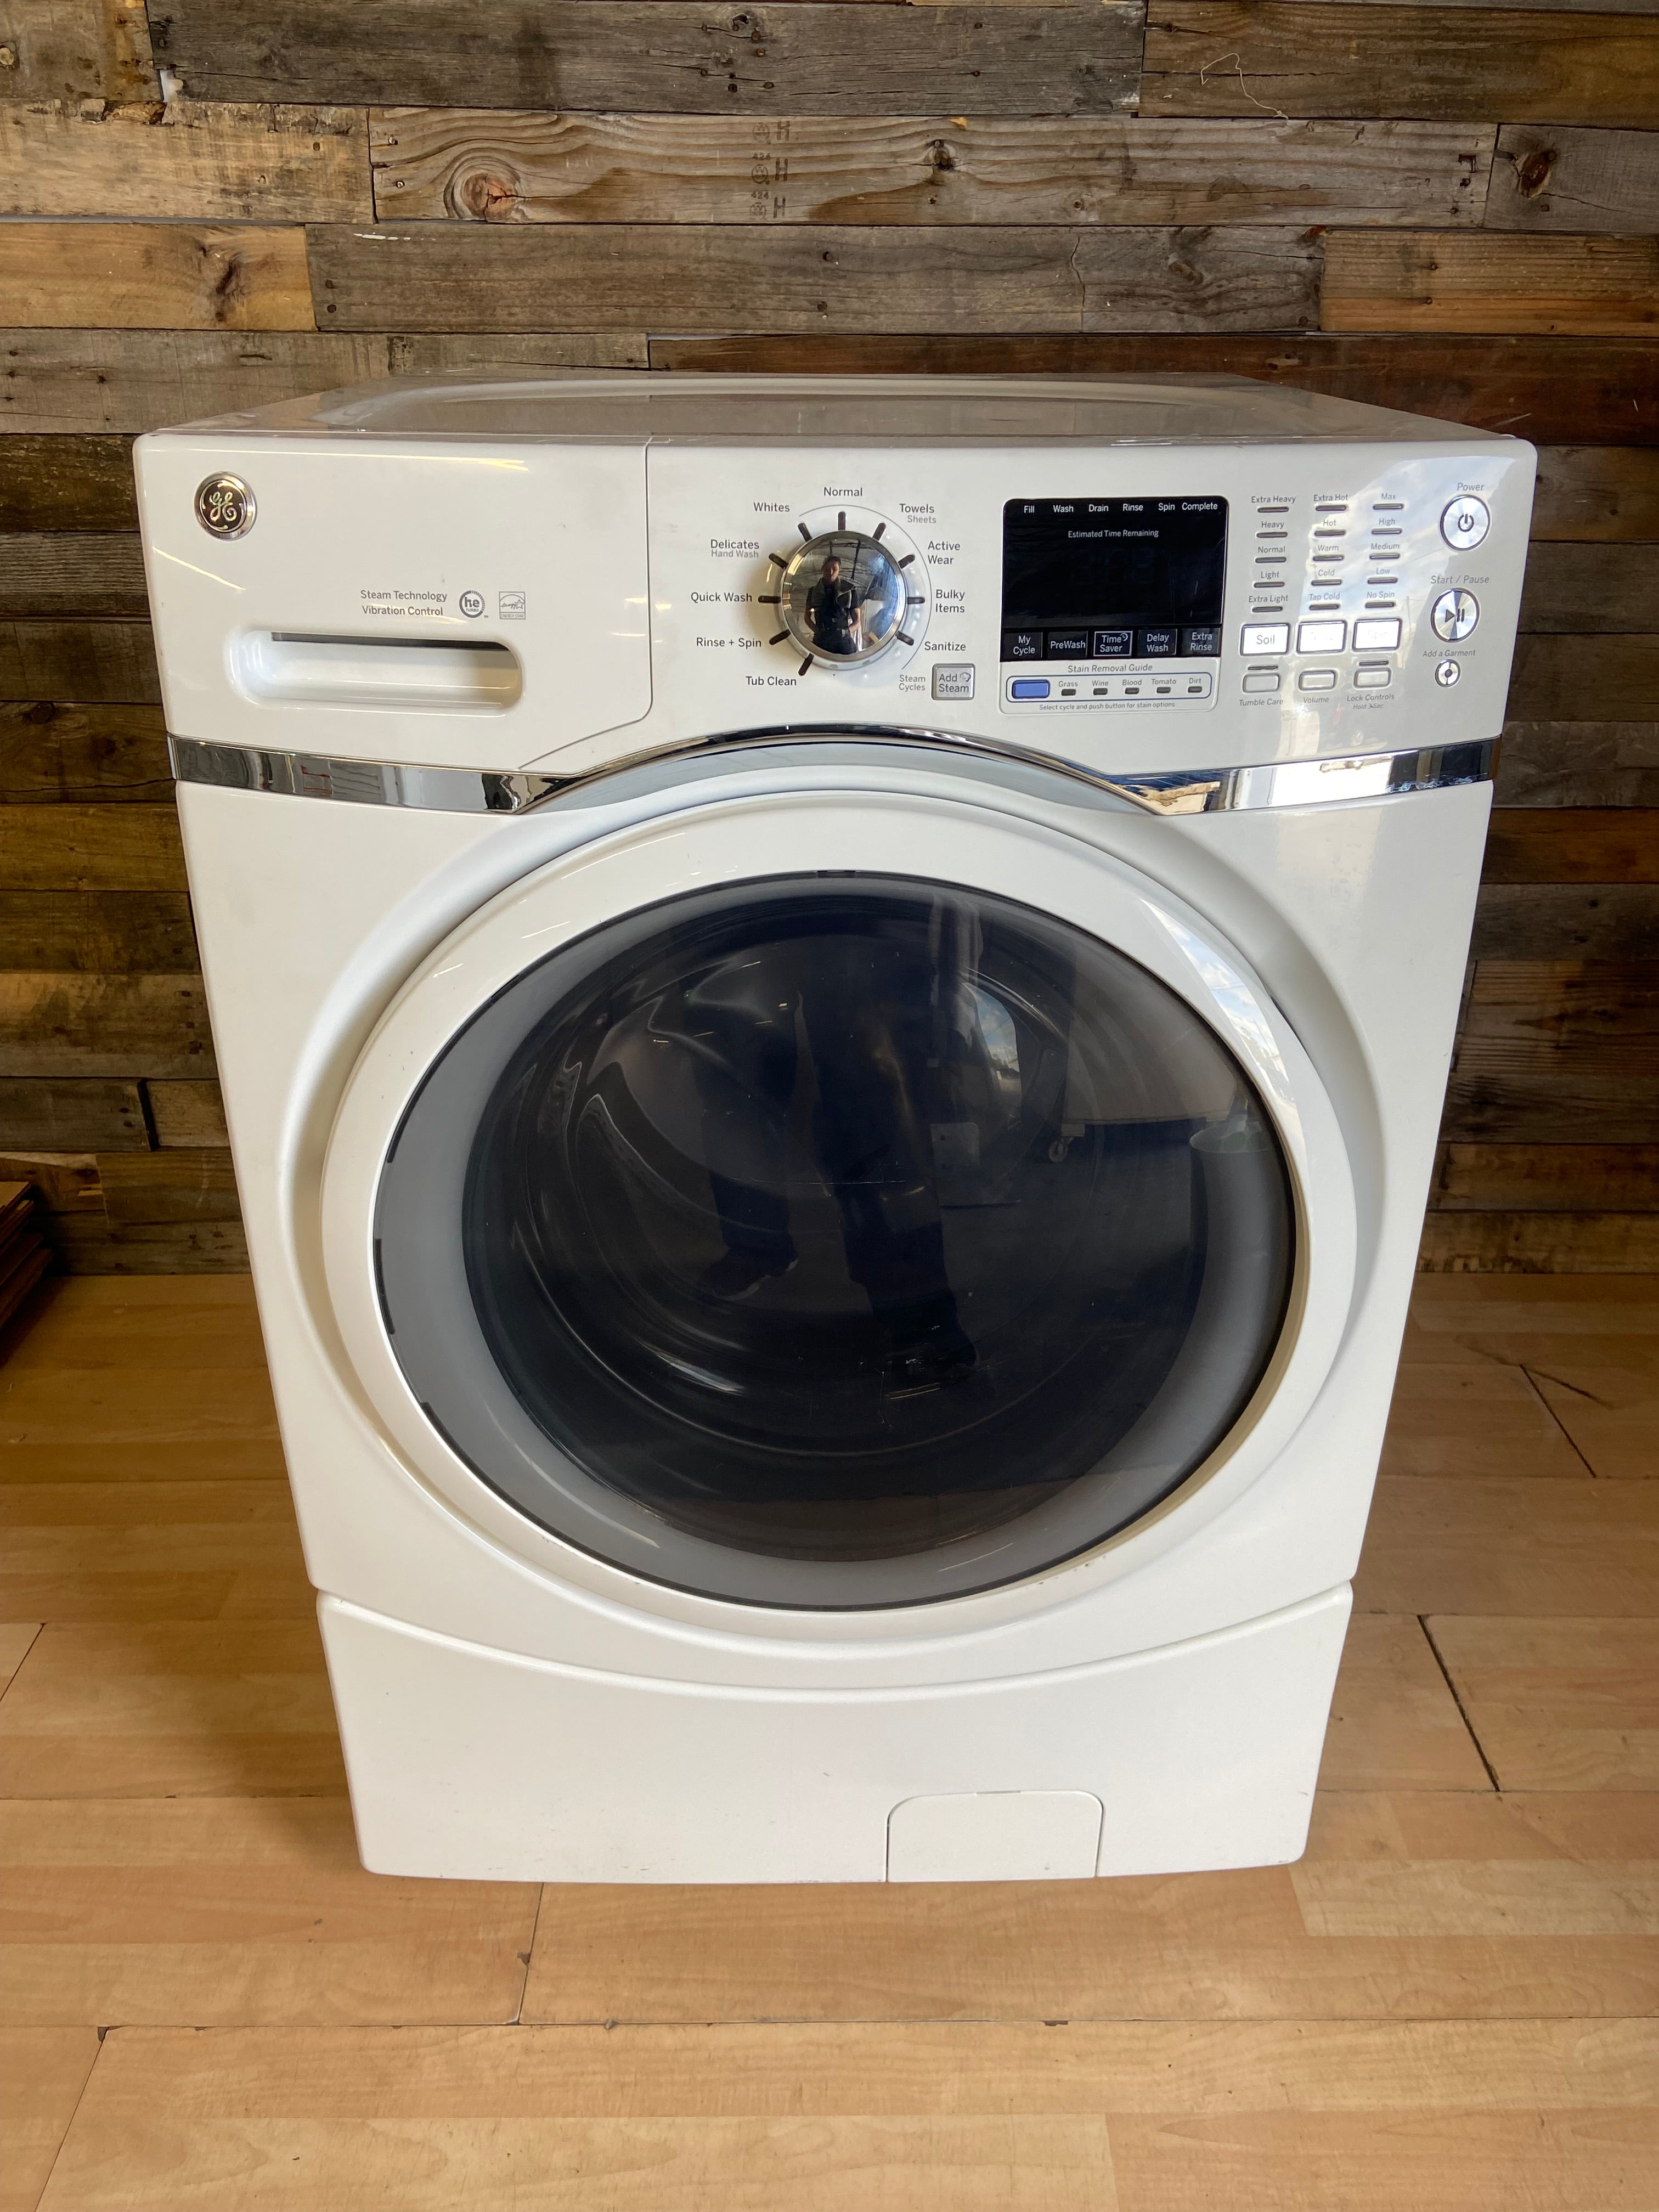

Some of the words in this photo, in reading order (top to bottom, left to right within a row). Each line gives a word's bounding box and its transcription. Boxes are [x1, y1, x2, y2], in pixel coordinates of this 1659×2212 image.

[775, 158, 788, 180] H
[1457, 483, 1484, 491] Power
[823, 488, 862, 496] Normal
[754, 503, 790, 512] Whites
[899, 504, 934, 513] Towels
[1024, 505, 1035, 514] Fill
[1158, 503, 1175, 512] Spin
[1182, 503, 1217, 511] Complete
[907, 515, 936, 524] Sheets
[1068, 530, 1103, 538] Estimated
[1123, 529, 1159, 538] Remaining
[710, 539, 759, 549] Delicates
[928, 541, 961, 550] Active
[711, 550, 732, 558] Hand
[735, 550, 759, 558] Wash
[928, 556, 953, 565] Wear
[1261, 571, 1279, 579] Light
[1431, 575, 1453, 584] Start
[1455, 575, 1460, 583] /
[360, 590, 391, 599] Steam
[393, 591, 447, 602] Technology
[691, 592, 722, 603] Quick
[725, 593, 752, 602] Wash
[936, 590, 965, 601] Bulky
[464, 597, 479, 608] he
[362, 606, 405, 615] Vibration
[408, 607, 443, 616] Control
[935, 604, 965, 613] Items
[1018, 636, 1031, 645] My
[1147, 634, 1169, 643] Delay
[1192, 633, 1212, 641] Extra
[1256, 635, 1275, 645] Soil
[696, 638, 725, 647] Rinse
[738, 638, 761, 650] Spin
[924, 642, 966, 651] Sanitize
[1051, 641, 1086, 649] PreWash
[1013, 646, 1035, 655] Cycle
[1068, 665, 1089, 673] Stain
[1092, 664, 1126, 673] Removal
[1128, 663, 1153, 672] Guide
[746, 677, 764, 686] Tub
[768, 676, 797, 686] Clean
[899, 675, 926, 683] Steam
[939, 673, 957, 682] Add
[899, 683, 926, 692] Cycles
[939, 683, 969, 693] Steam
